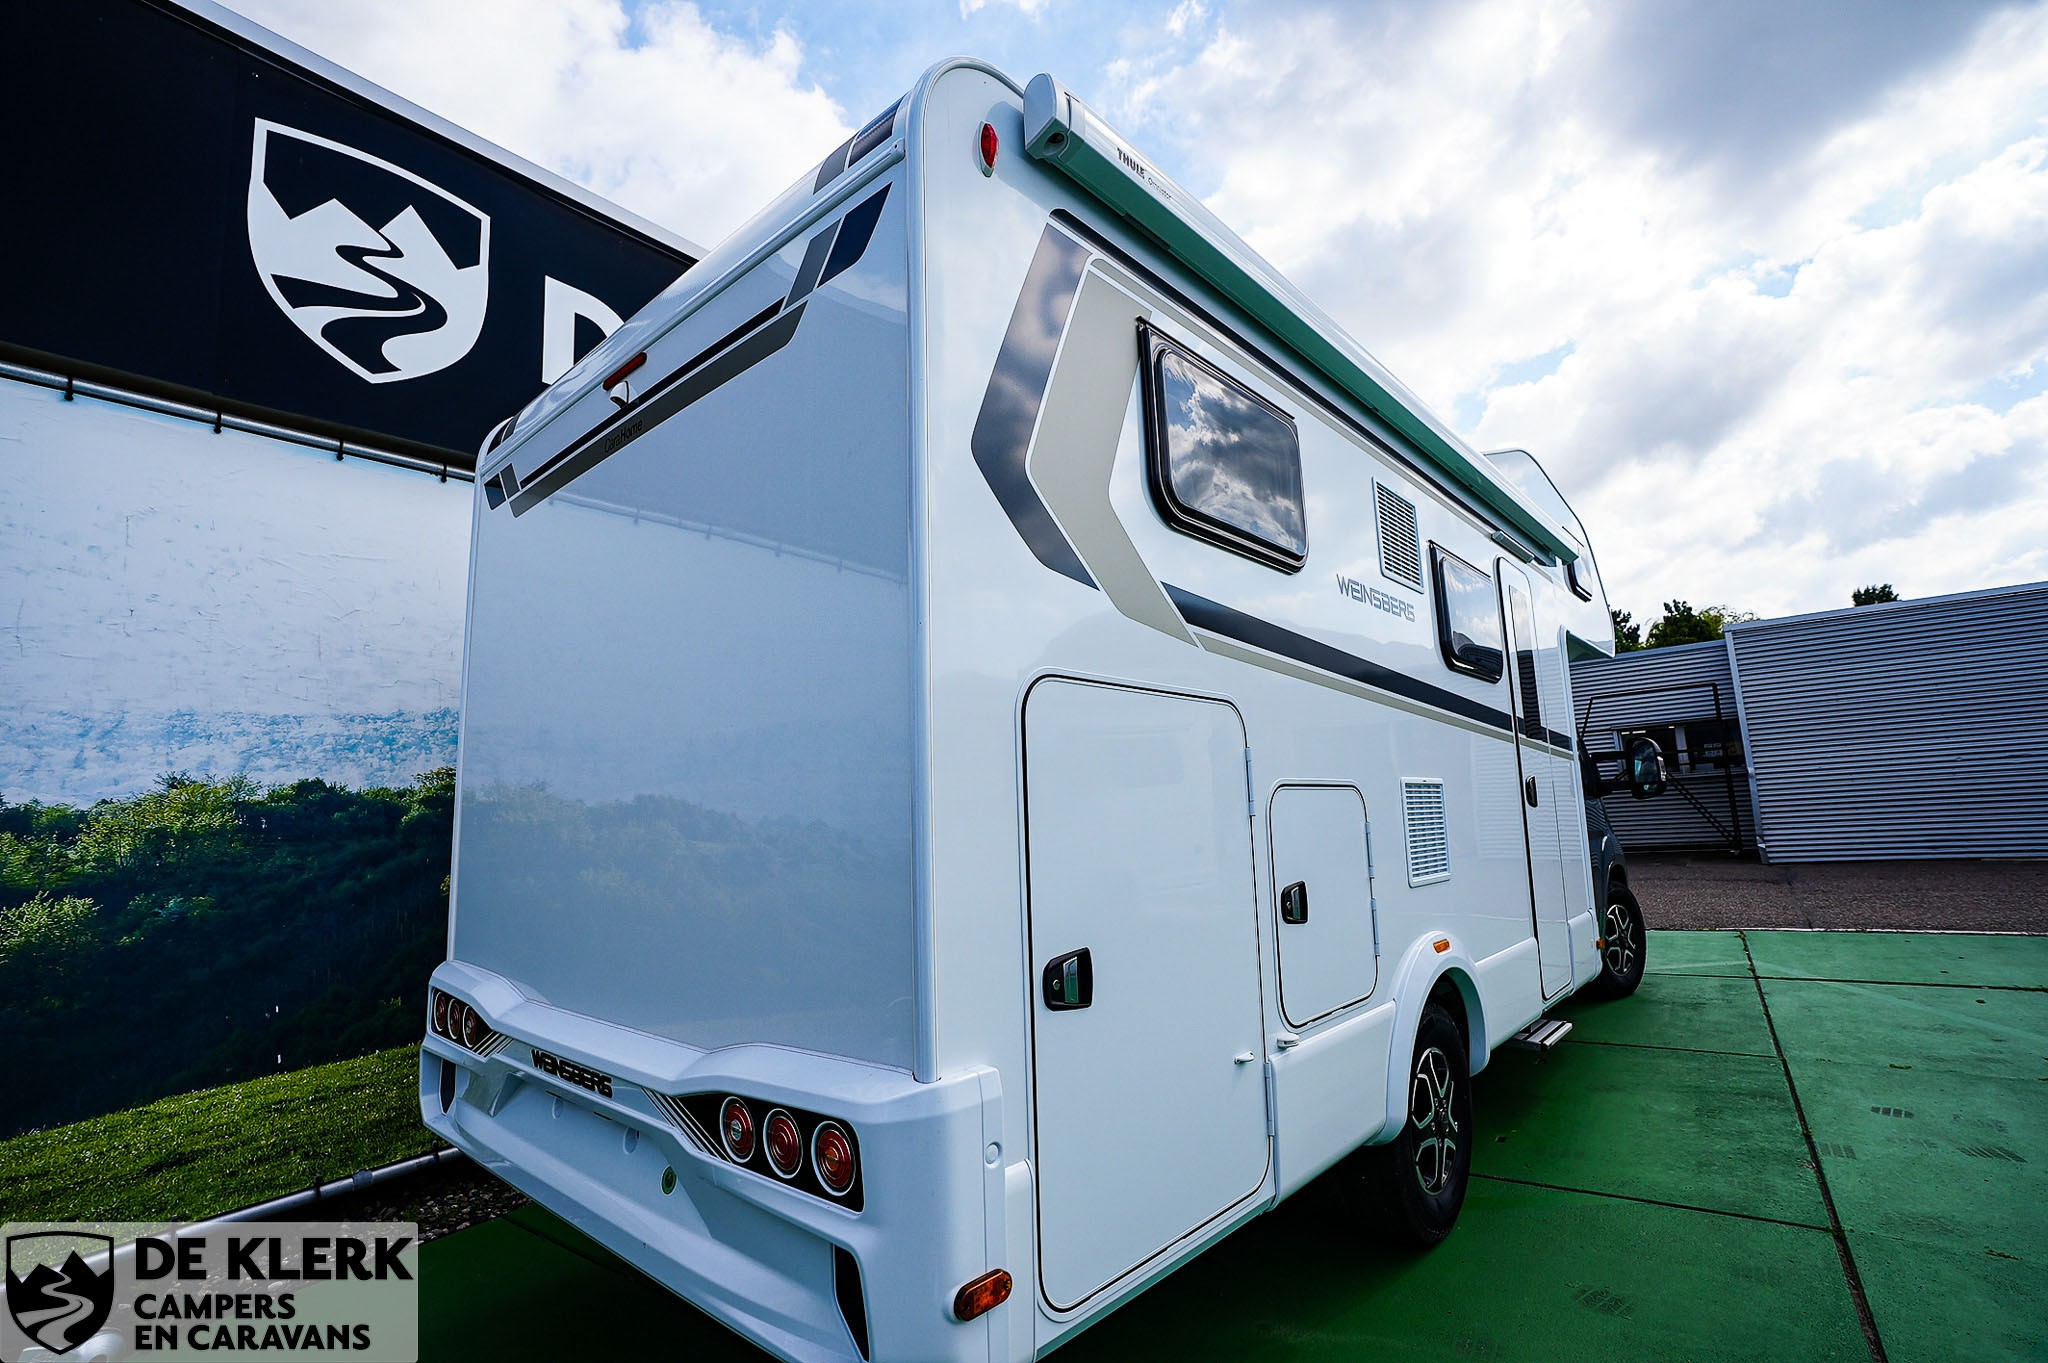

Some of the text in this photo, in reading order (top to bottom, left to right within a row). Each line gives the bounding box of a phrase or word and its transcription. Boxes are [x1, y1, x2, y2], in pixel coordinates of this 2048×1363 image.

[1116, 147, 1146, 179] THULE
[603, 419, 643, 453] CaraHome
[1336, 573, 1416, 622] WEINSBERG
[530, 1048, 613, 1099] WEINSBERG
